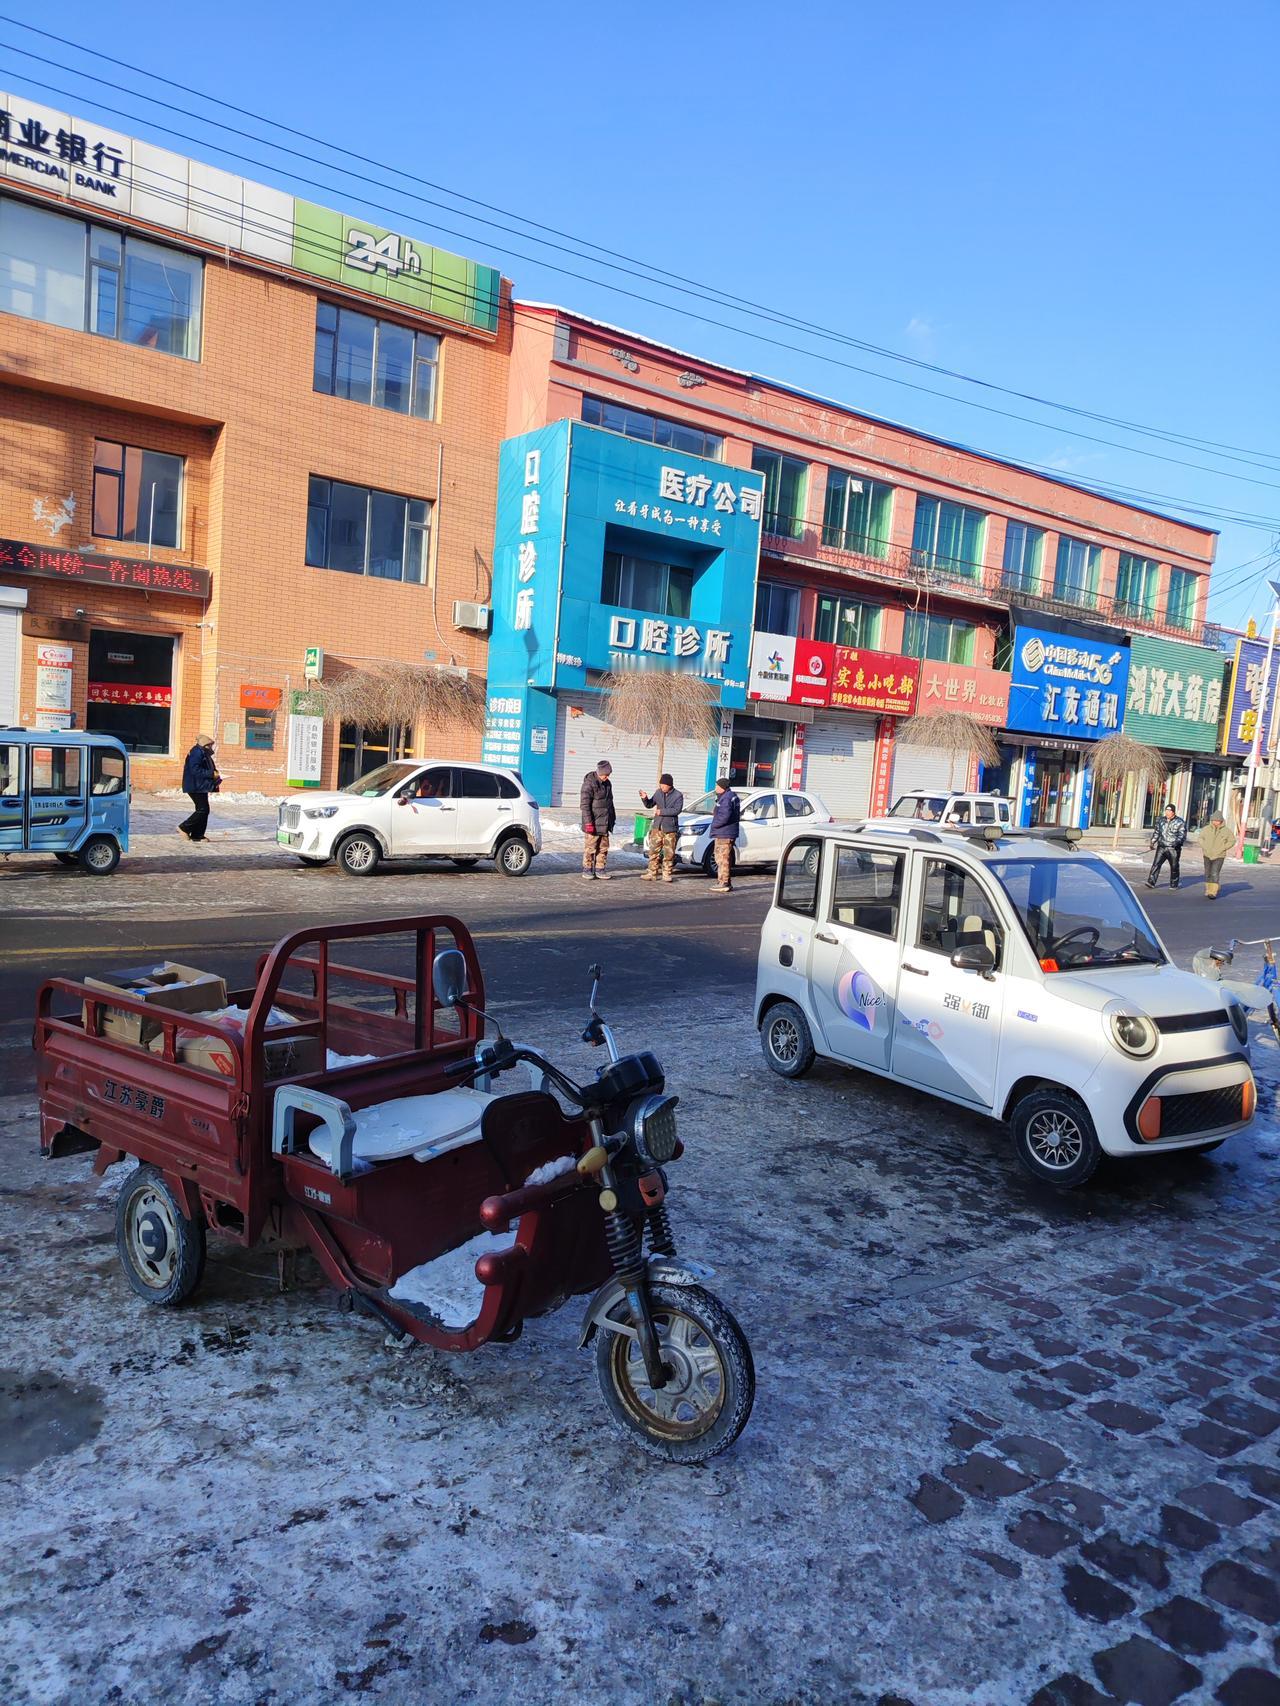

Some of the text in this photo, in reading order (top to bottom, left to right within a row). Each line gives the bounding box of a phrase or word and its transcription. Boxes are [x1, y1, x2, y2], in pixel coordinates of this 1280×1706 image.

[75, 171, 117, 198] BANK
[345, 229, 421, 278] 24h
[659, 466, 763, 520] 医疗公司
[615, 499, 722, 537] 让看牙成为一种享受
[514, 449, 541, 631] 口腔诊所
[607, 615, 733, 662] 口腔诊所
[1045, 644, 1089, 668] 中国移动
[926, 673, 977, 703] 大世界
[1042, 683, 1119, 729] 汇友通讯
[1127, 664, 1222, 724] 鸿济大药房
[858, 992, 887, 1008] Nice!
[104, 1079, 166, 1120] 江苏豪爵
